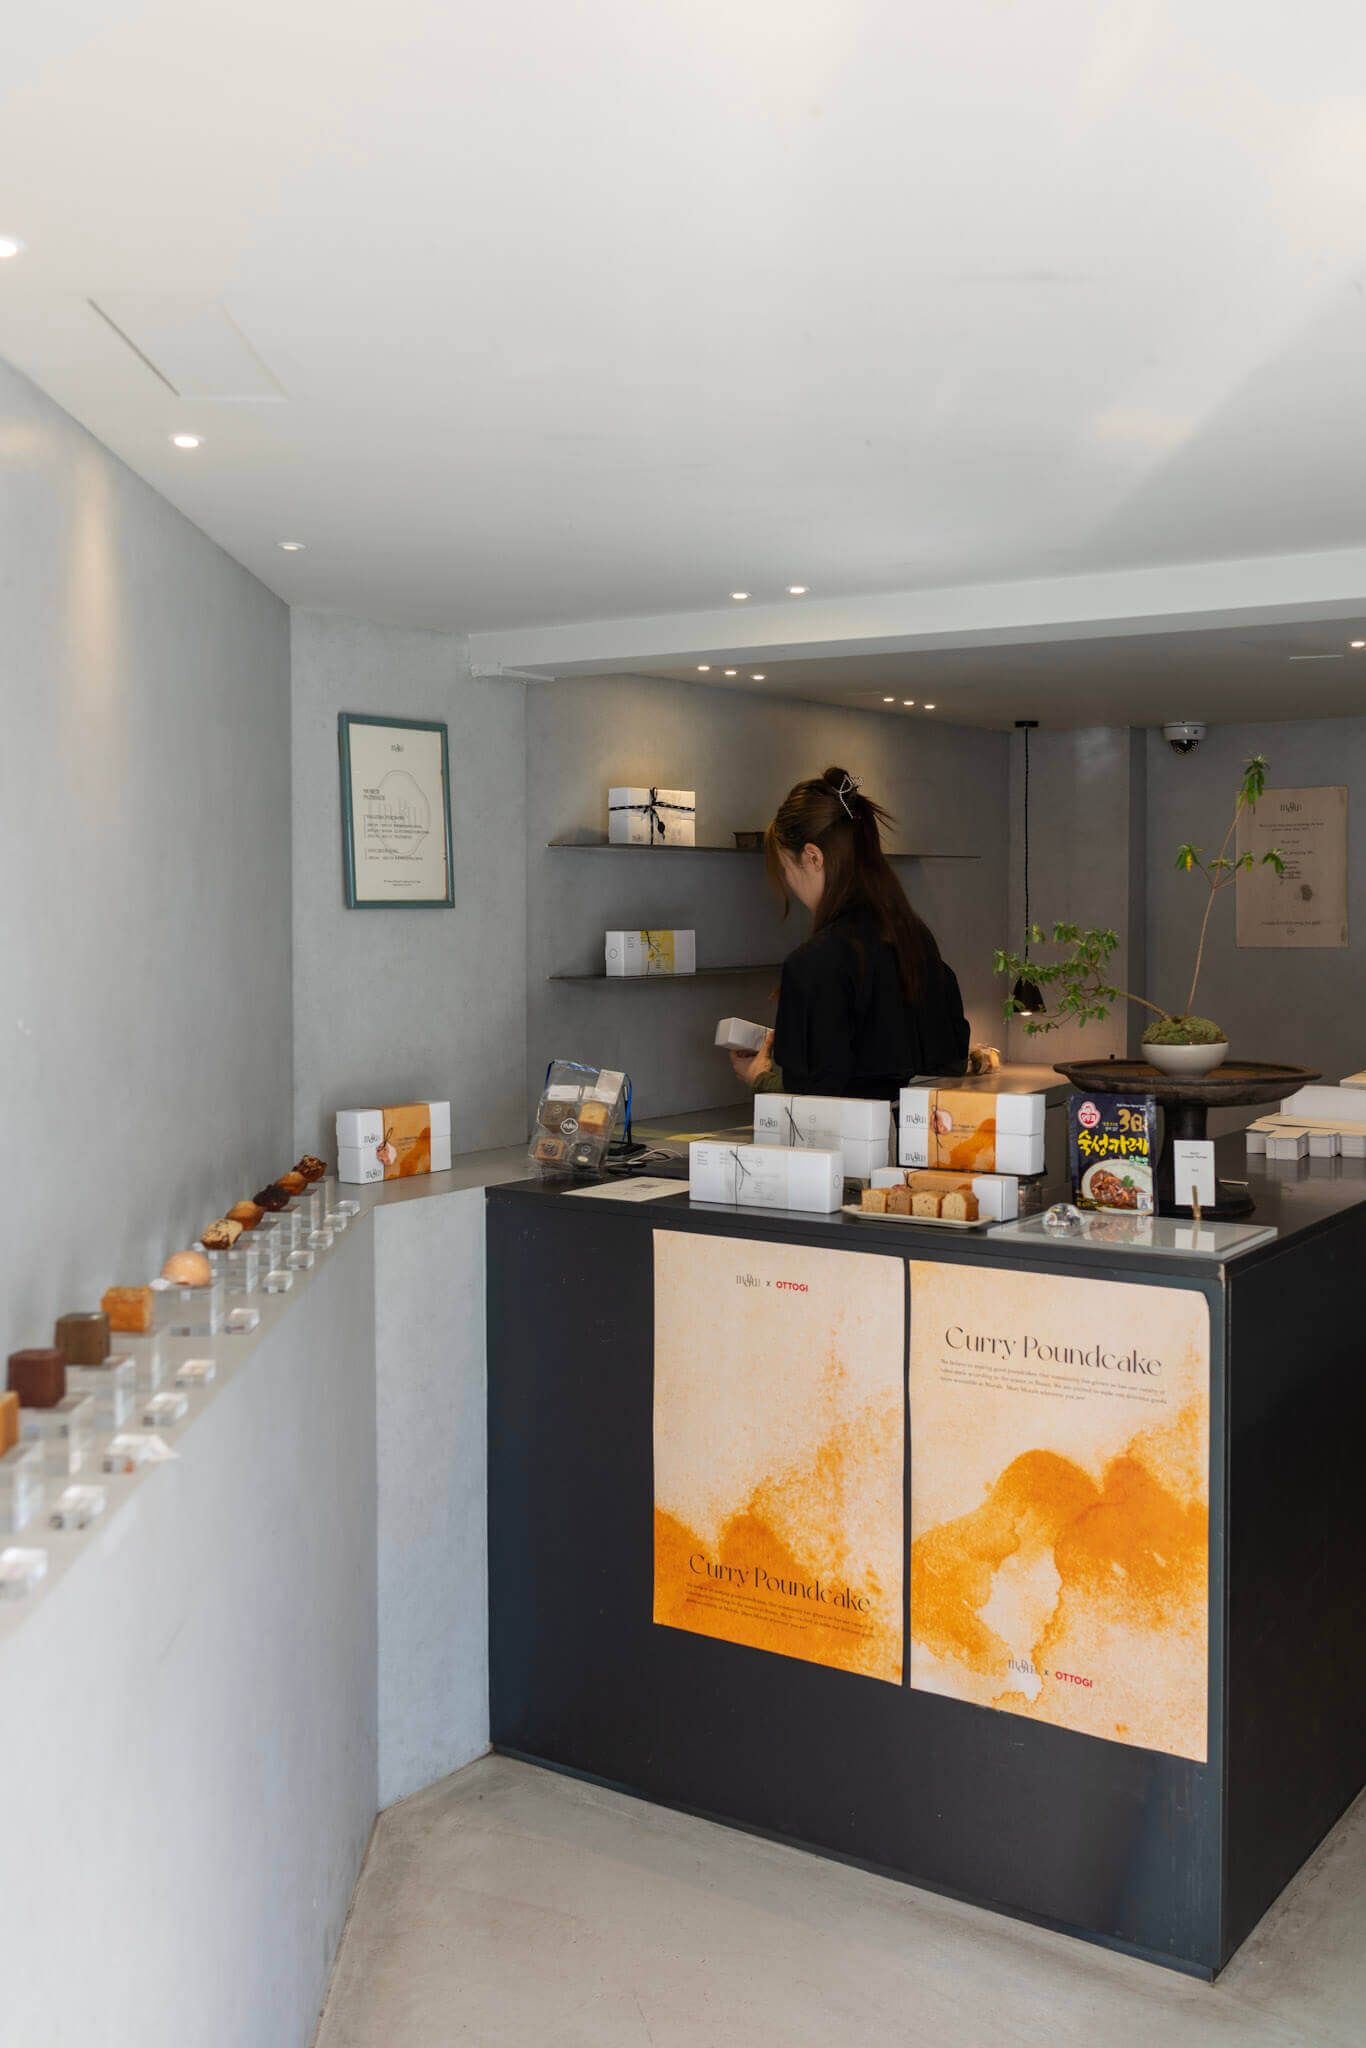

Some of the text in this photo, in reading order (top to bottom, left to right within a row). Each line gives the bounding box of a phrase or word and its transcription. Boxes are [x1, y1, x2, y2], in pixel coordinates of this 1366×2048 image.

[775, 1280, 809, 1293] OTTOGI
[945, 1326, 1017, 1361] Curry
[1023, 1335, 1163, 1377] Poundcake
[689, 1553, 750, 1588] Curry
[754, 1567, 871, 1614] Poundcake
[1054, 1671, 1094, 1688] OTTOGI
